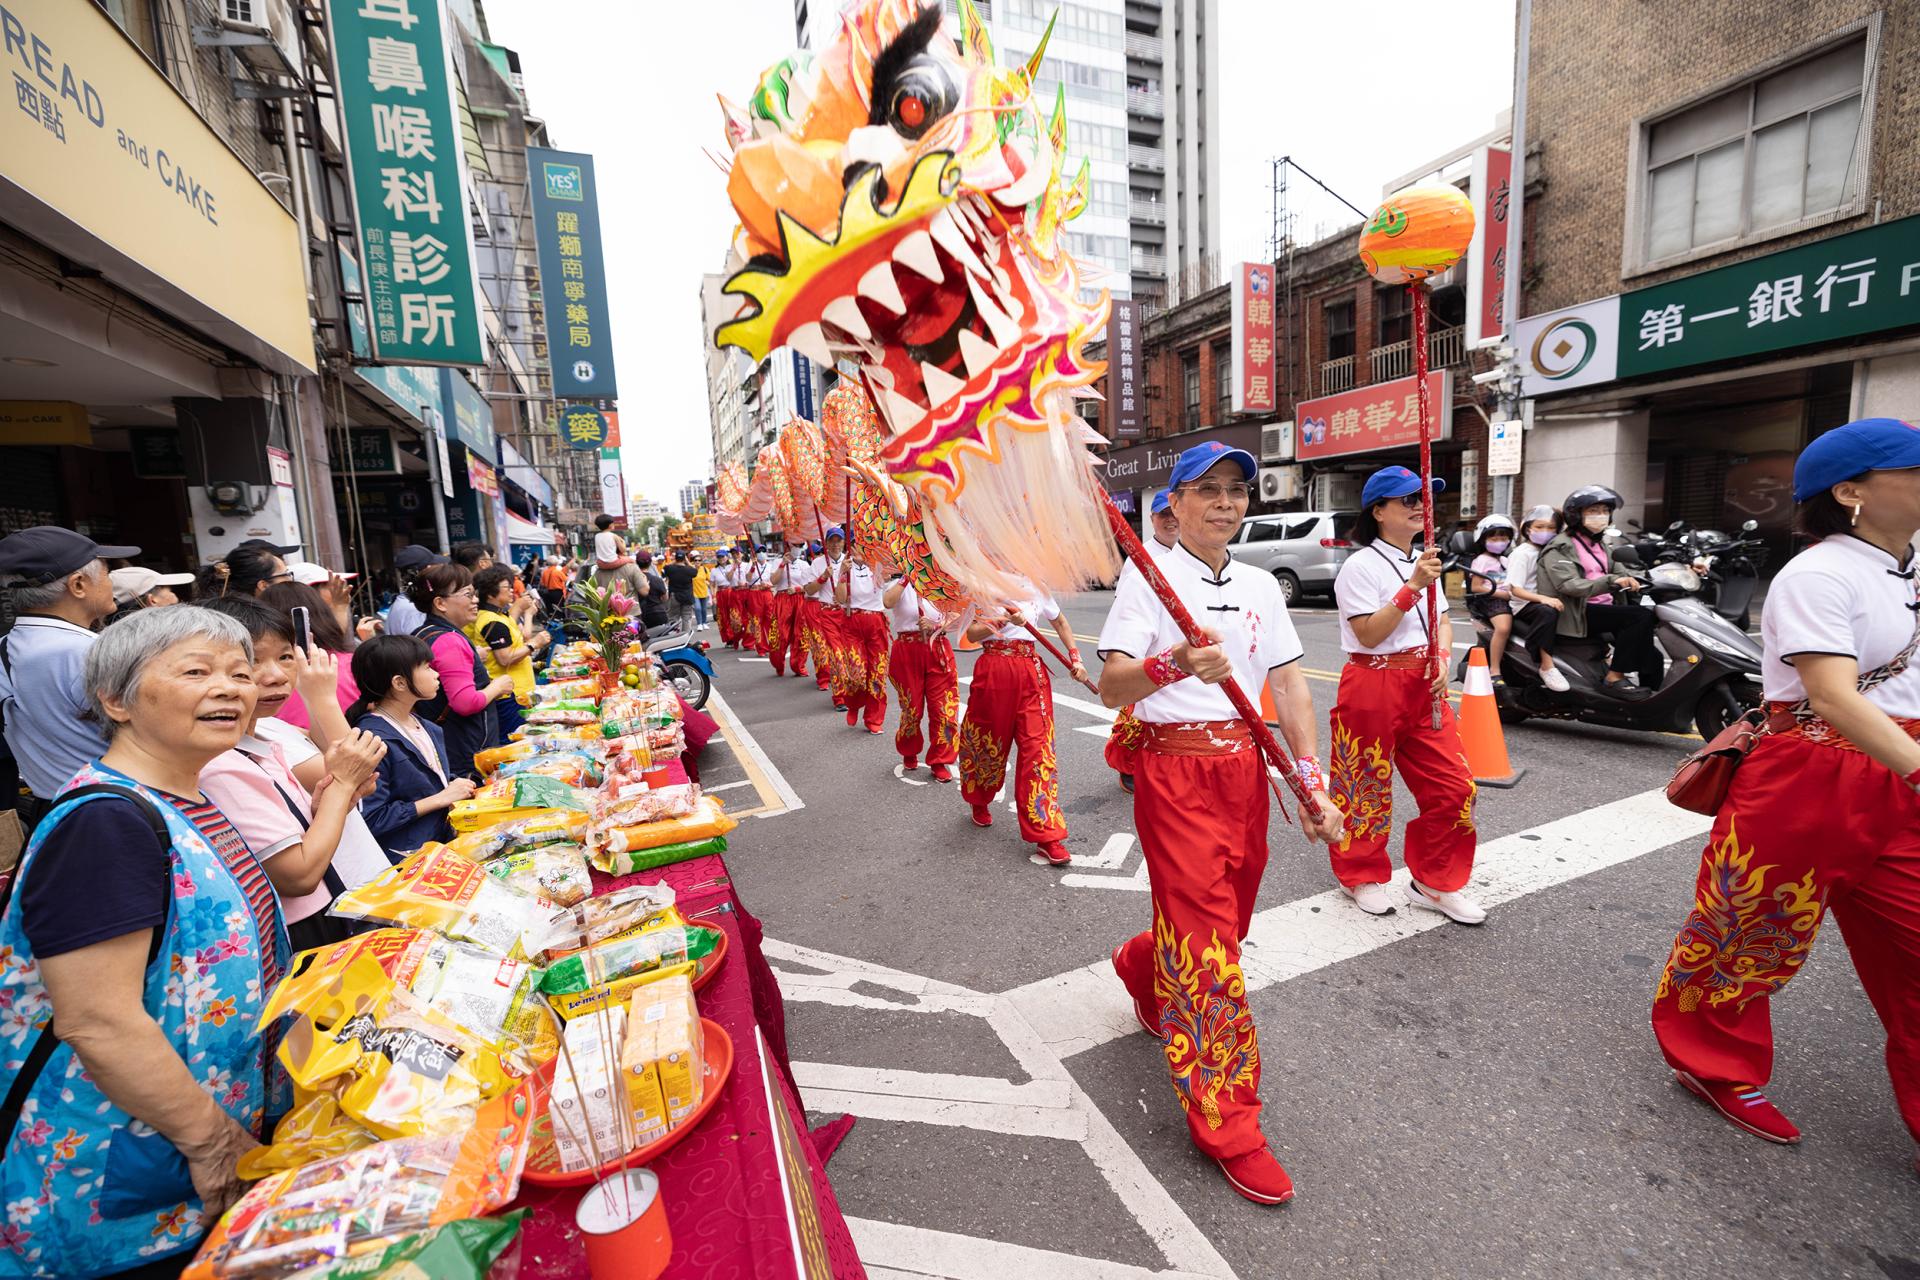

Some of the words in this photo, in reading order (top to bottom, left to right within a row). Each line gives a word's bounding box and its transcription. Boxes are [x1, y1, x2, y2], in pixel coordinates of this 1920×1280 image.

[12, 71, 66, 144] 西點
[117, 128, 149, 168] and
[157, 150, 218, 226] CAKE
[548, 174, 574, 189] YES
[556, 211, 591, 348] 躍獅南寧藥局
[1637, 257, 1877, 351] 第一銀行
[1246, 298, 1271, 406] 韓華屋
[567, 413, 603, 444] 藥
[1330, 392, 1434, 440] 韓華屋
[1107, 458, 1139, 478] Great
[1147, 449, 1182, 472] Livin
